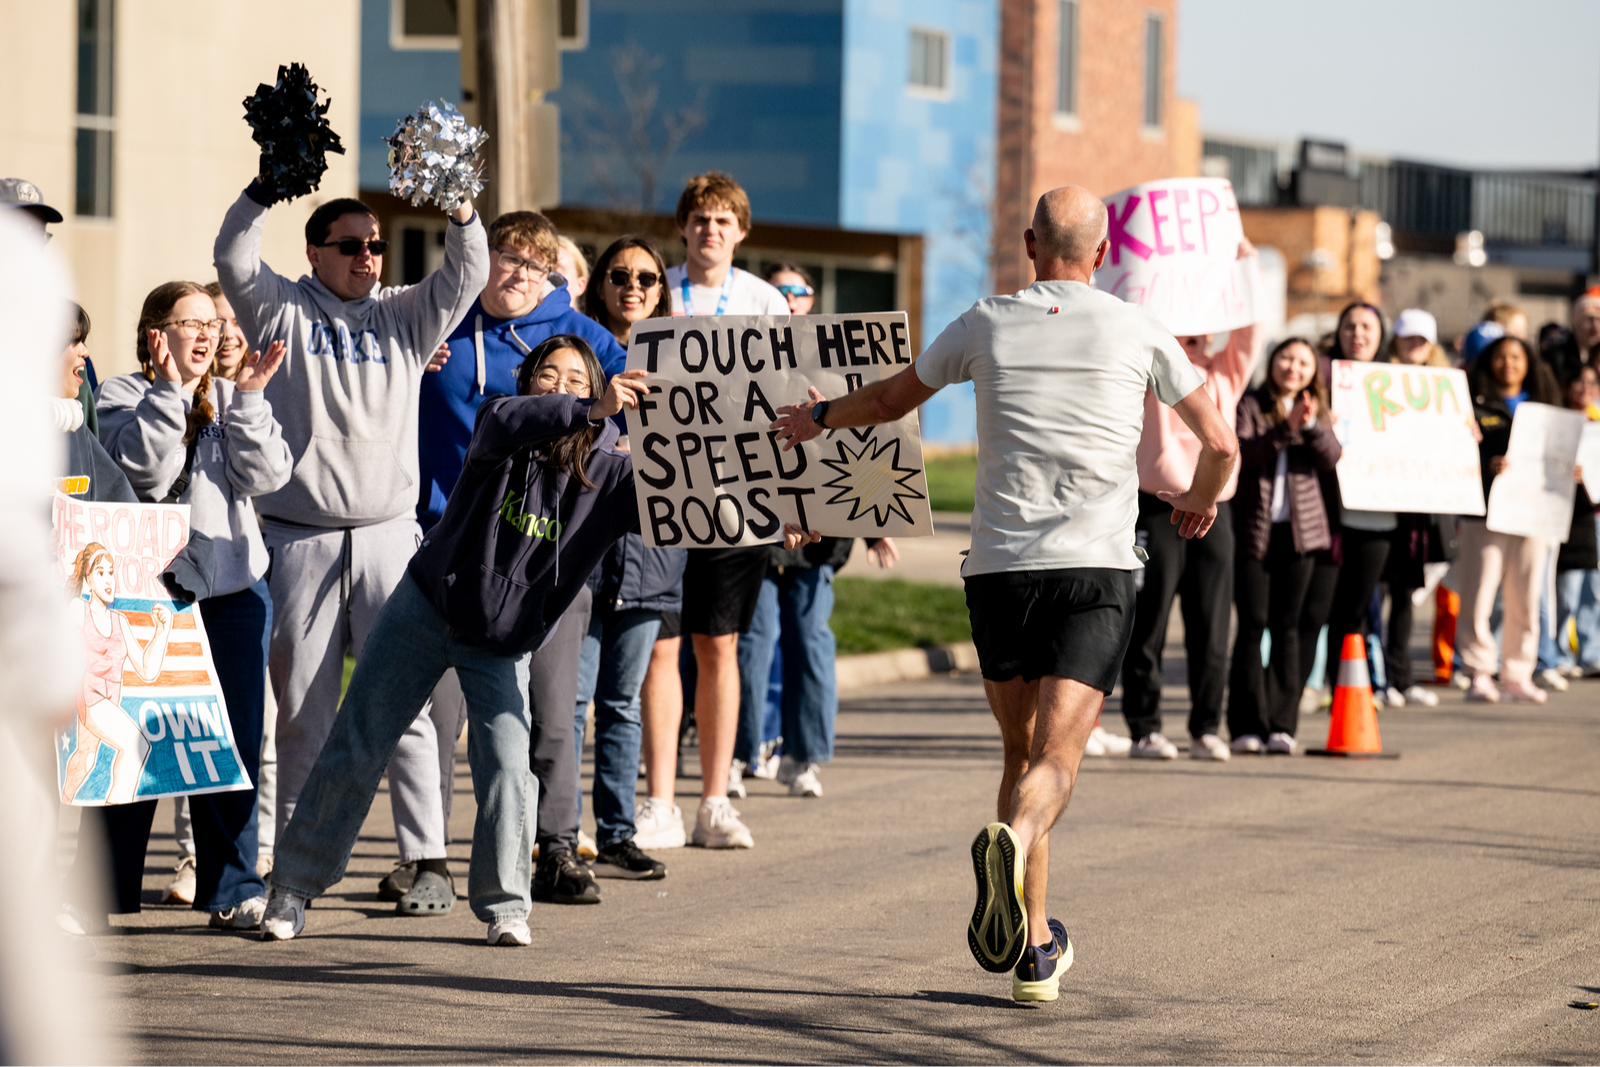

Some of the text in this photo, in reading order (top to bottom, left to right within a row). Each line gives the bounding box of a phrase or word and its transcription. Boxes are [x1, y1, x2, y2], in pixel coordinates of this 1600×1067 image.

[1107, 188, 1220, 267] KEEP
[307, 320, 388, 365] DRAKE
[635, 319, 911, 375] TOUCH HERE
[637, 380, 778, 427] FOR A
[638, 430, 808, 490] SPEED
[56, 497, 188, 559] THE ROAD
[646, 487, 816, 547] BOOST
[138, 700, 225, 742] OWN
[173, 739, 221, 785] IT
